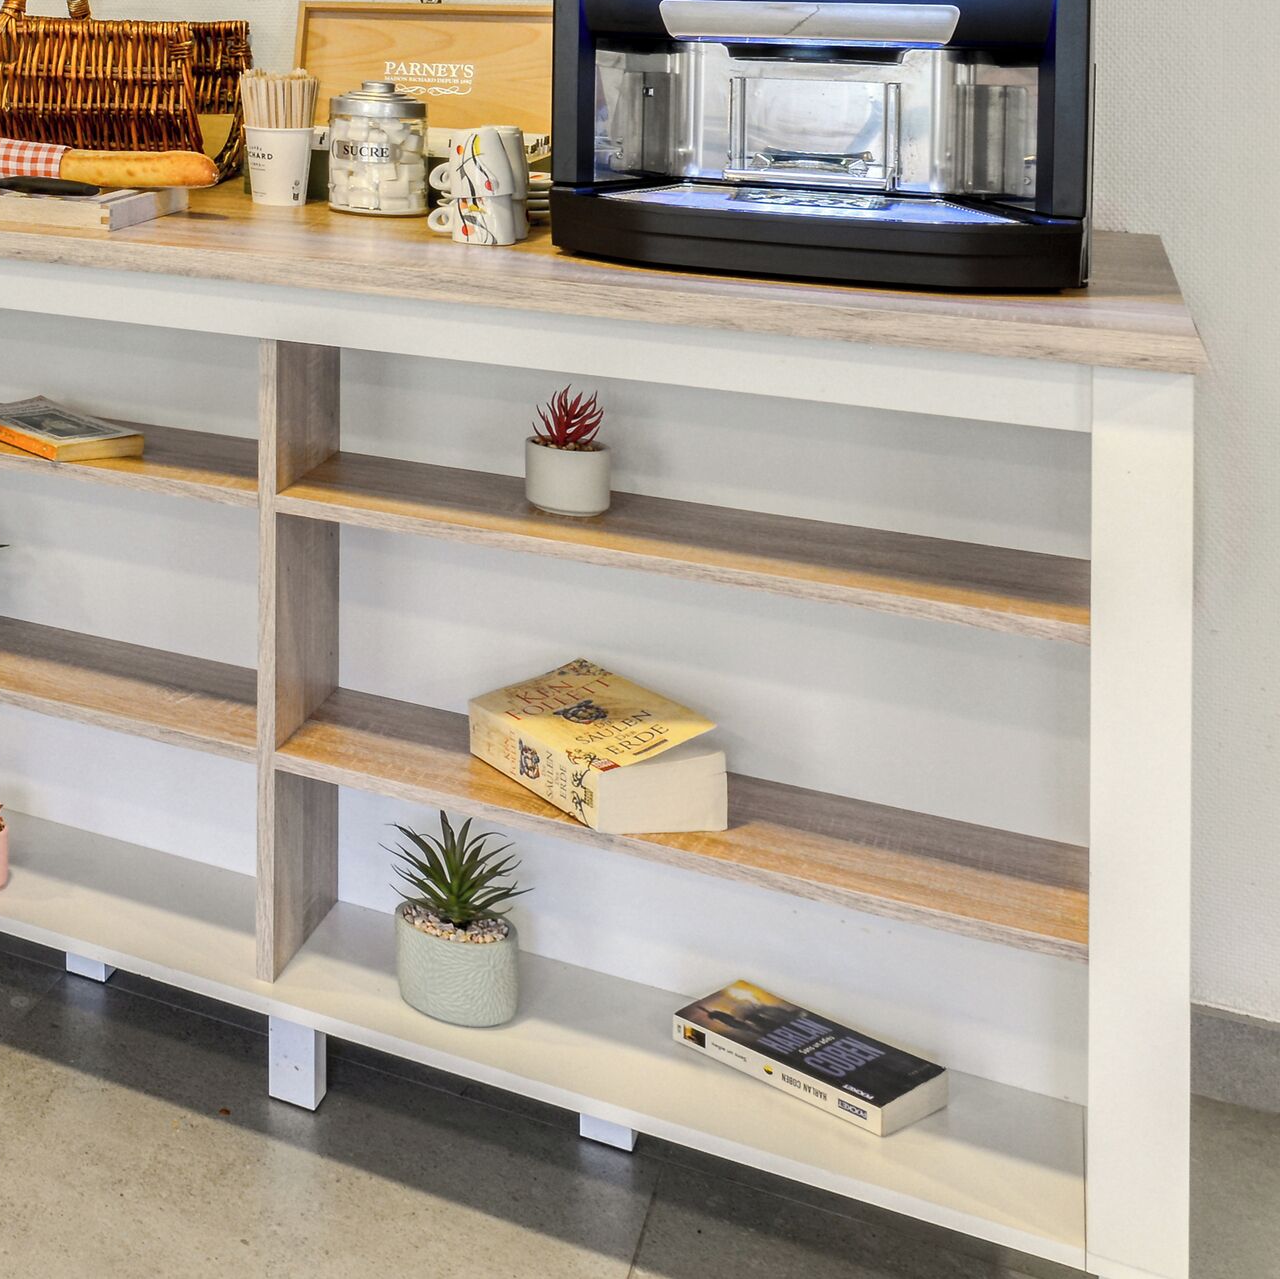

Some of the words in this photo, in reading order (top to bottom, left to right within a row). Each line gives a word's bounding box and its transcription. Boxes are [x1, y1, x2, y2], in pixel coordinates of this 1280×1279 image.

[384, 60, 474, 79] PARNEY'S
[248, 150, 274, 161] CHARD
[342, 144, 390, 159] SUCRE
[504, 677, 611, 722] FOLLETT
[516, 680, 575, 705] KEN
[605, 723, 670, 756] ERDE
[559, 764, 567, 800] ERDE
[757, 1016, 834, 1055] HARLAN
[803, 1035, 887, 1079] COBEN
[780, 1073, 802, 1090] COBEN
[802, 1083, 828, 1102] HARLAN
[841, 1083, 875, 1101] POCKET
